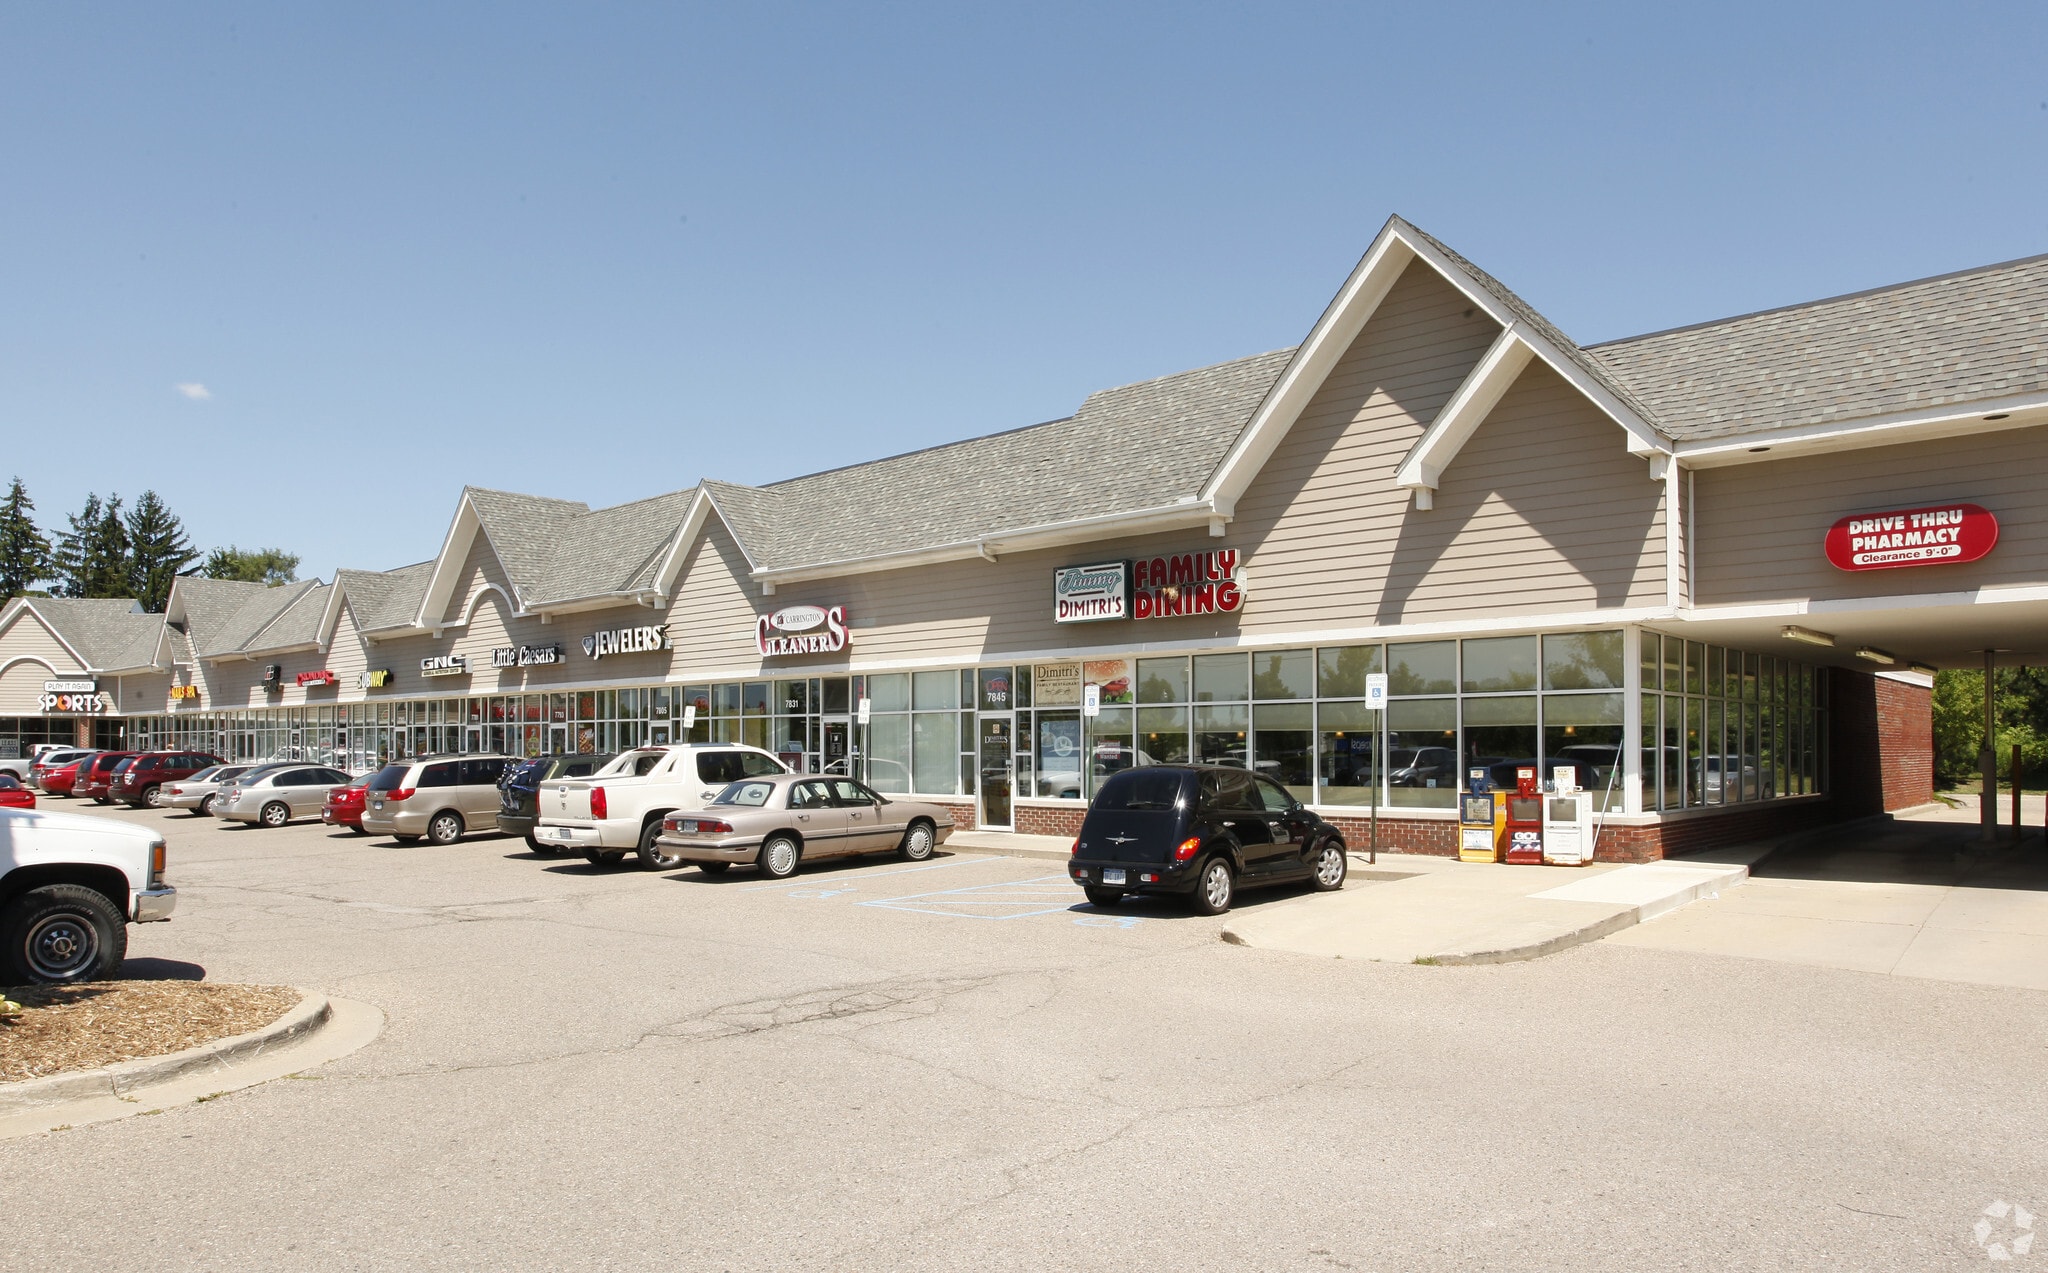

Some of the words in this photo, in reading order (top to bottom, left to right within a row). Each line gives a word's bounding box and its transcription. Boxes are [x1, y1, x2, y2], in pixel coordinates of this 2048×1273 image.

[1850, 515, 1905, 535] DRIVE
[1910, 509, 1963, 528] THRU
[1852, 527, 1961, 551] PHARMACY
[1861, 550, 1921, 563] Clearance
[1925, 547, 1953, 557] 9'-0"
[1134, 549, 1238, 588] FAMILY
[1059, 595, 1122, 618] DIMITRI'S
[1134, 581, 1242, 620] DINING
[785, 613, 821, 625] CARRINGTON
[756, 606, 846, 657] CLEANERS
[594, 624, 666, 661] JEWELERS
[421, 654, 463, 670] GNC
[491, 648, 516, 667] Little
[519, 645, 556, 667] Caesars
[358, 670, 388, 690] SUBWAY
[1037, 664, 1080, 679] Dimitri's
[71, 682, 92, 690] AGAIN
[37, 694, 103, 712] SPORTS
[785, 700, 799, 708] 7831
[987, 692, 1006, 702] 7845
